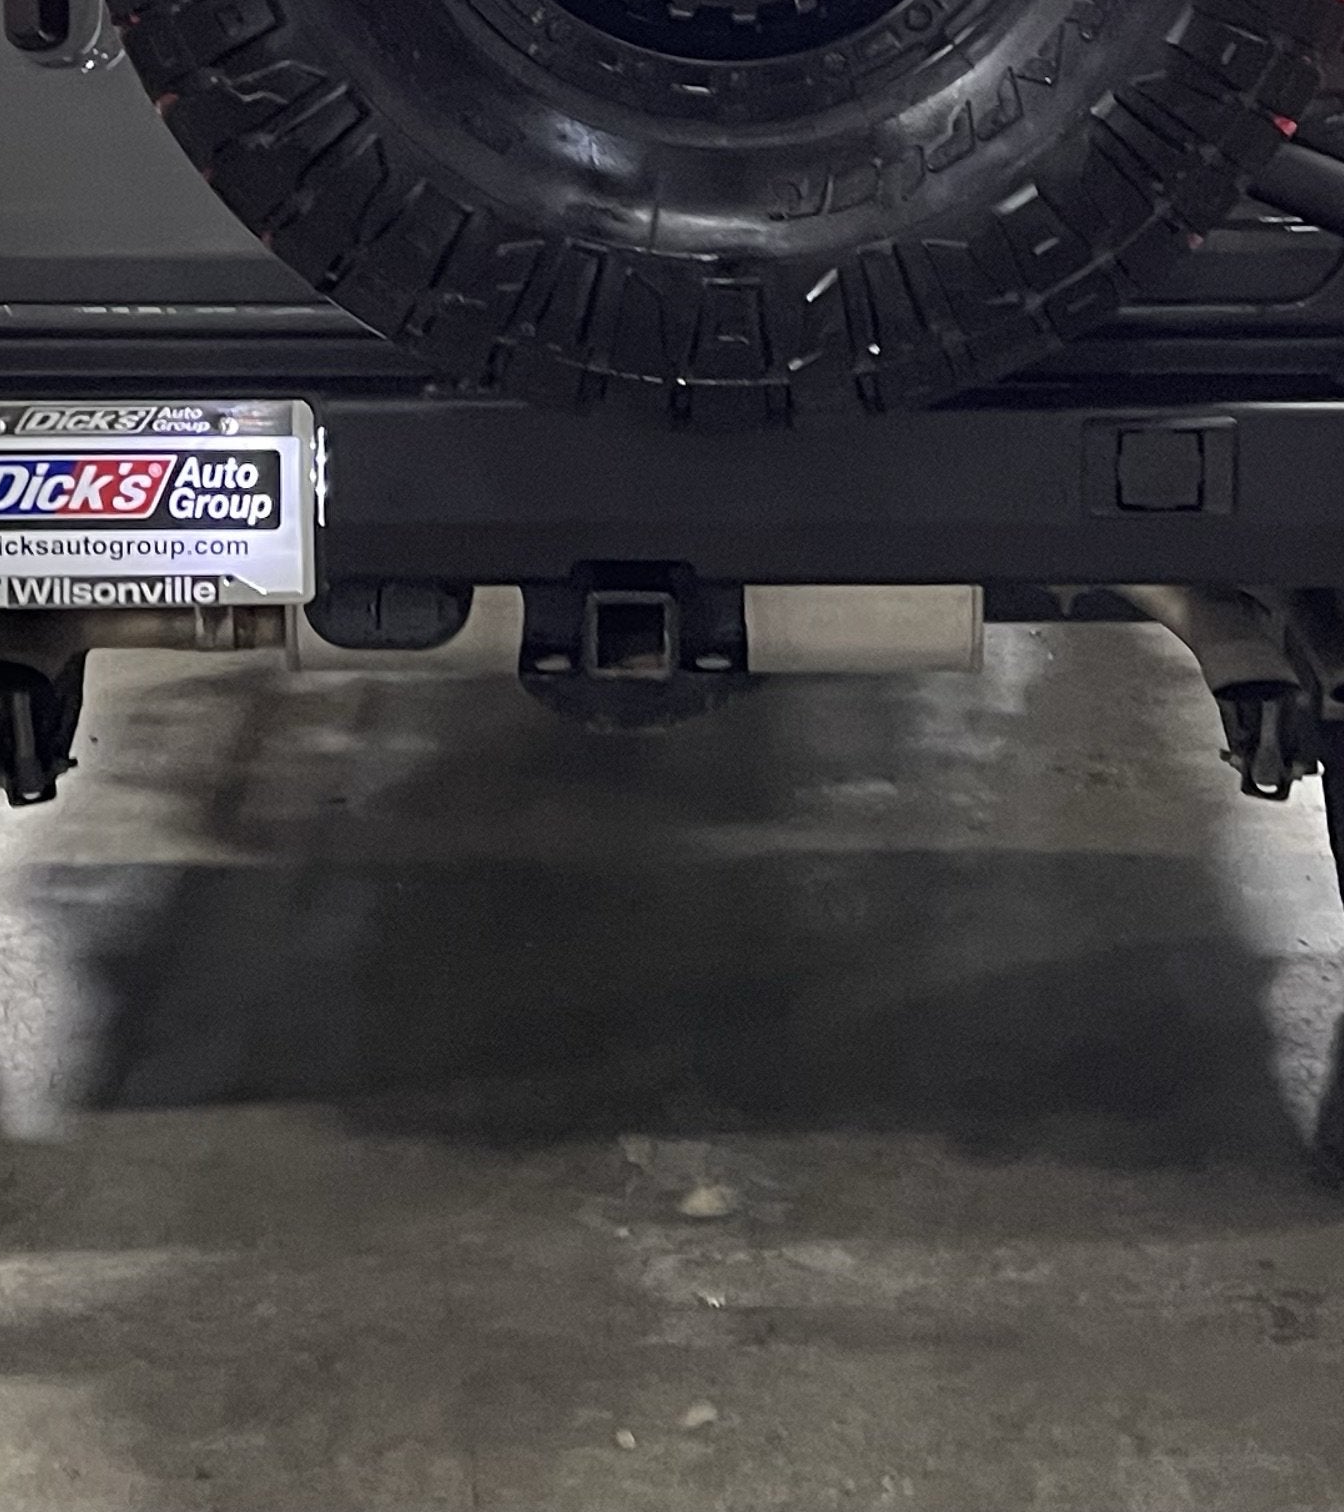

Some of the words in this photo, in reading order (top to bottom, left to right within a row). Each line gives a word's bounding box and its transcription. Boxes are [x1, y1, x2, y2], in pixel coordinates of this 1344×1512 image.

[152, 419, 211, 435] Group
[156, 406, 203, 420] Auto
[174, 457, 259, 489] Auto
[168, 488, 273, 526] Group
[8, 575, 217, 606] Wilsonville
